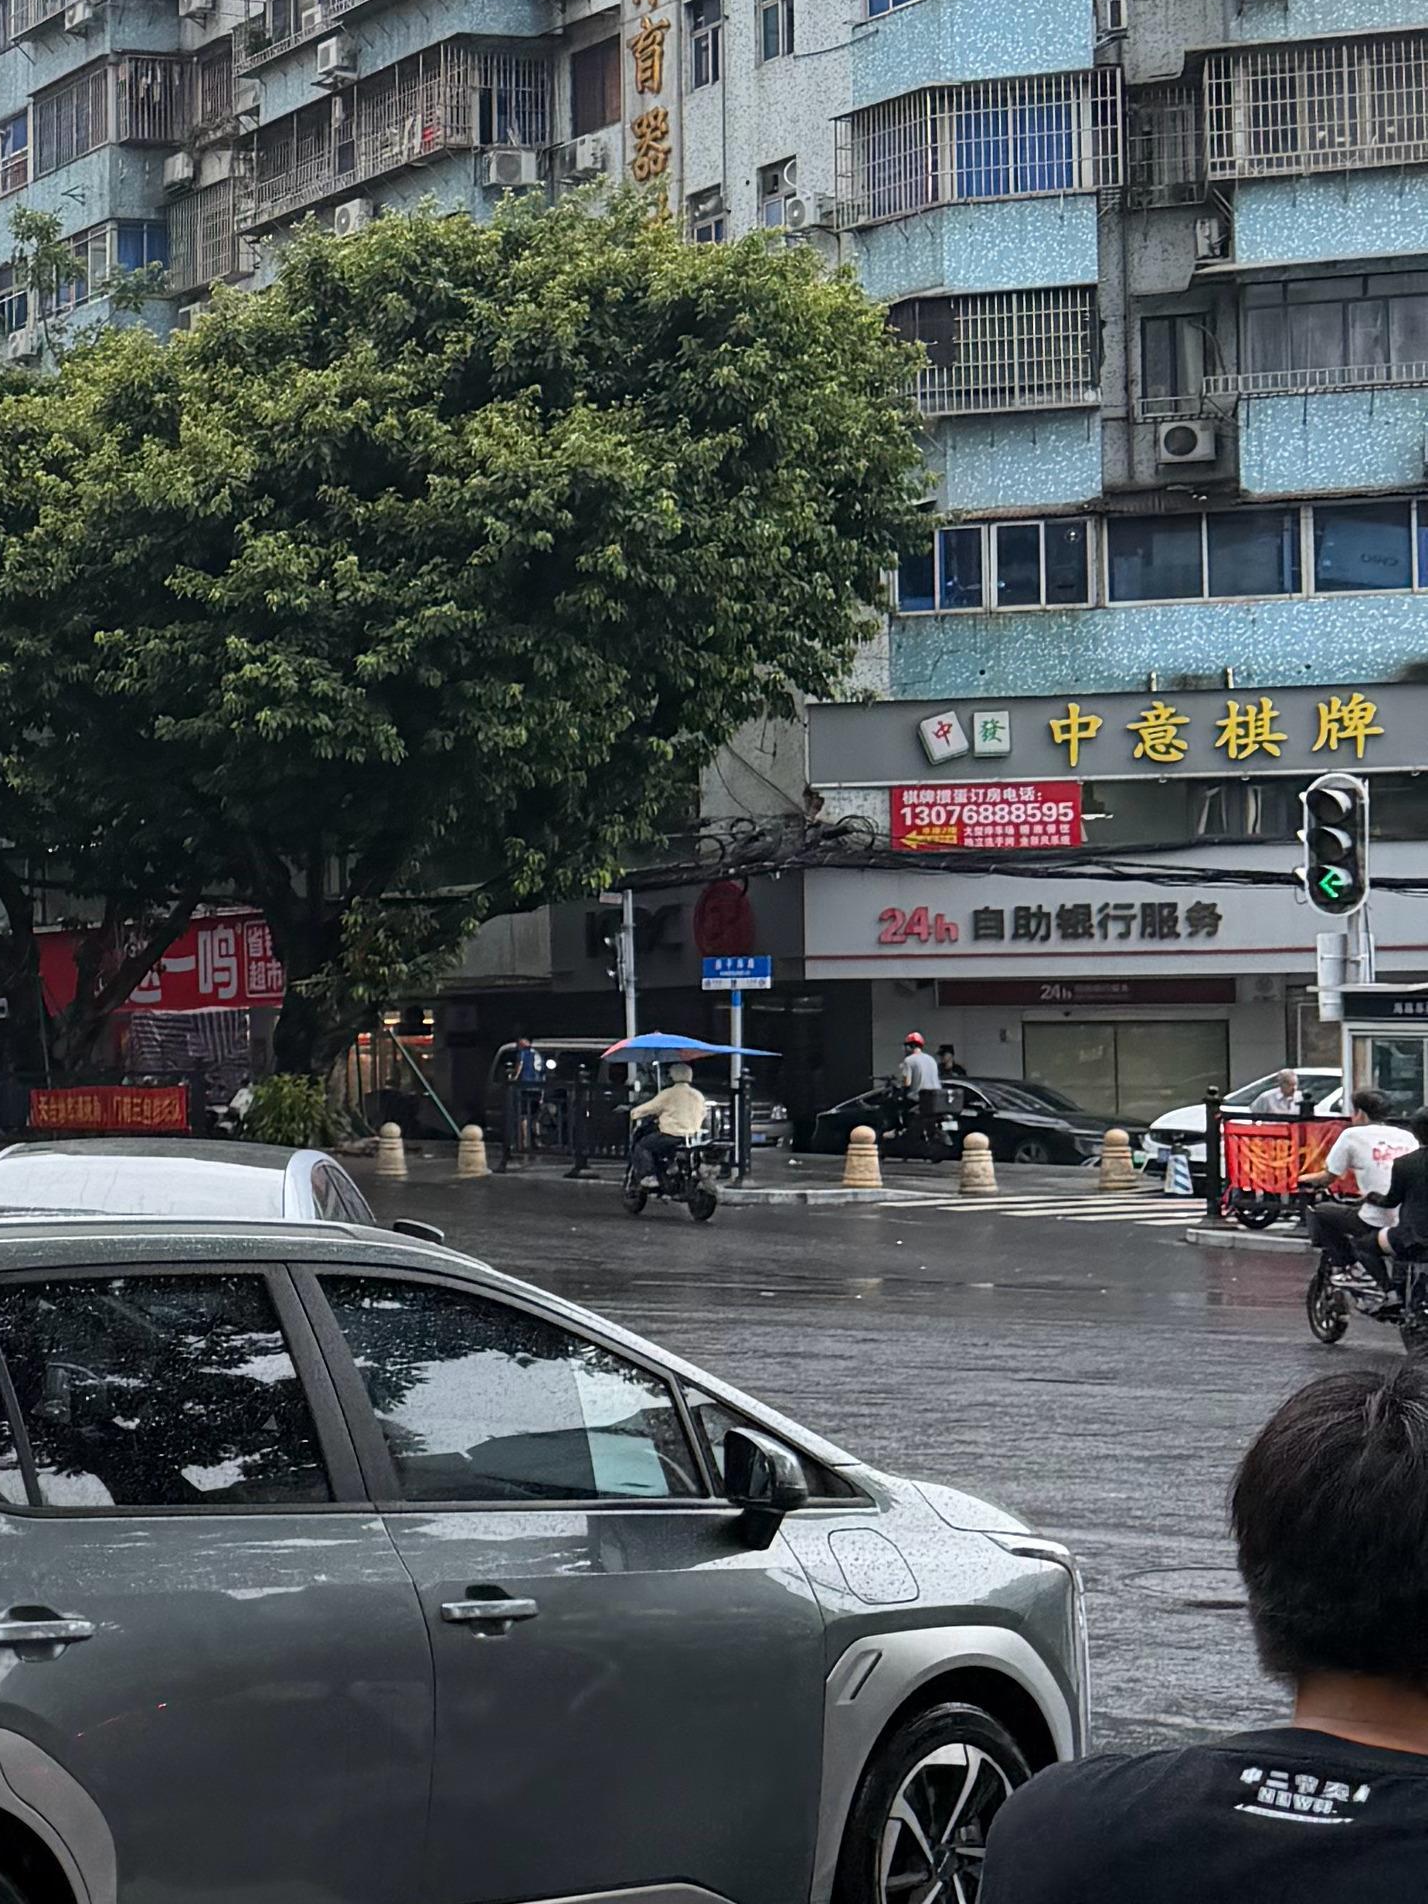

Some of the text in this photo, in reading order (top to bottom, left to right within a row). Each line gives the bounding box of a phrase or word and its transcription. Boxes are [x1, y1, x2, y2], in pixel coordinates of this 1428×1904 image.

[1048, 692, 1385, 768] 中意棋牌
[900, 802, 1075, 826] 13076888595
[878, 900, 1223, 945] 24h 自助银行服务
